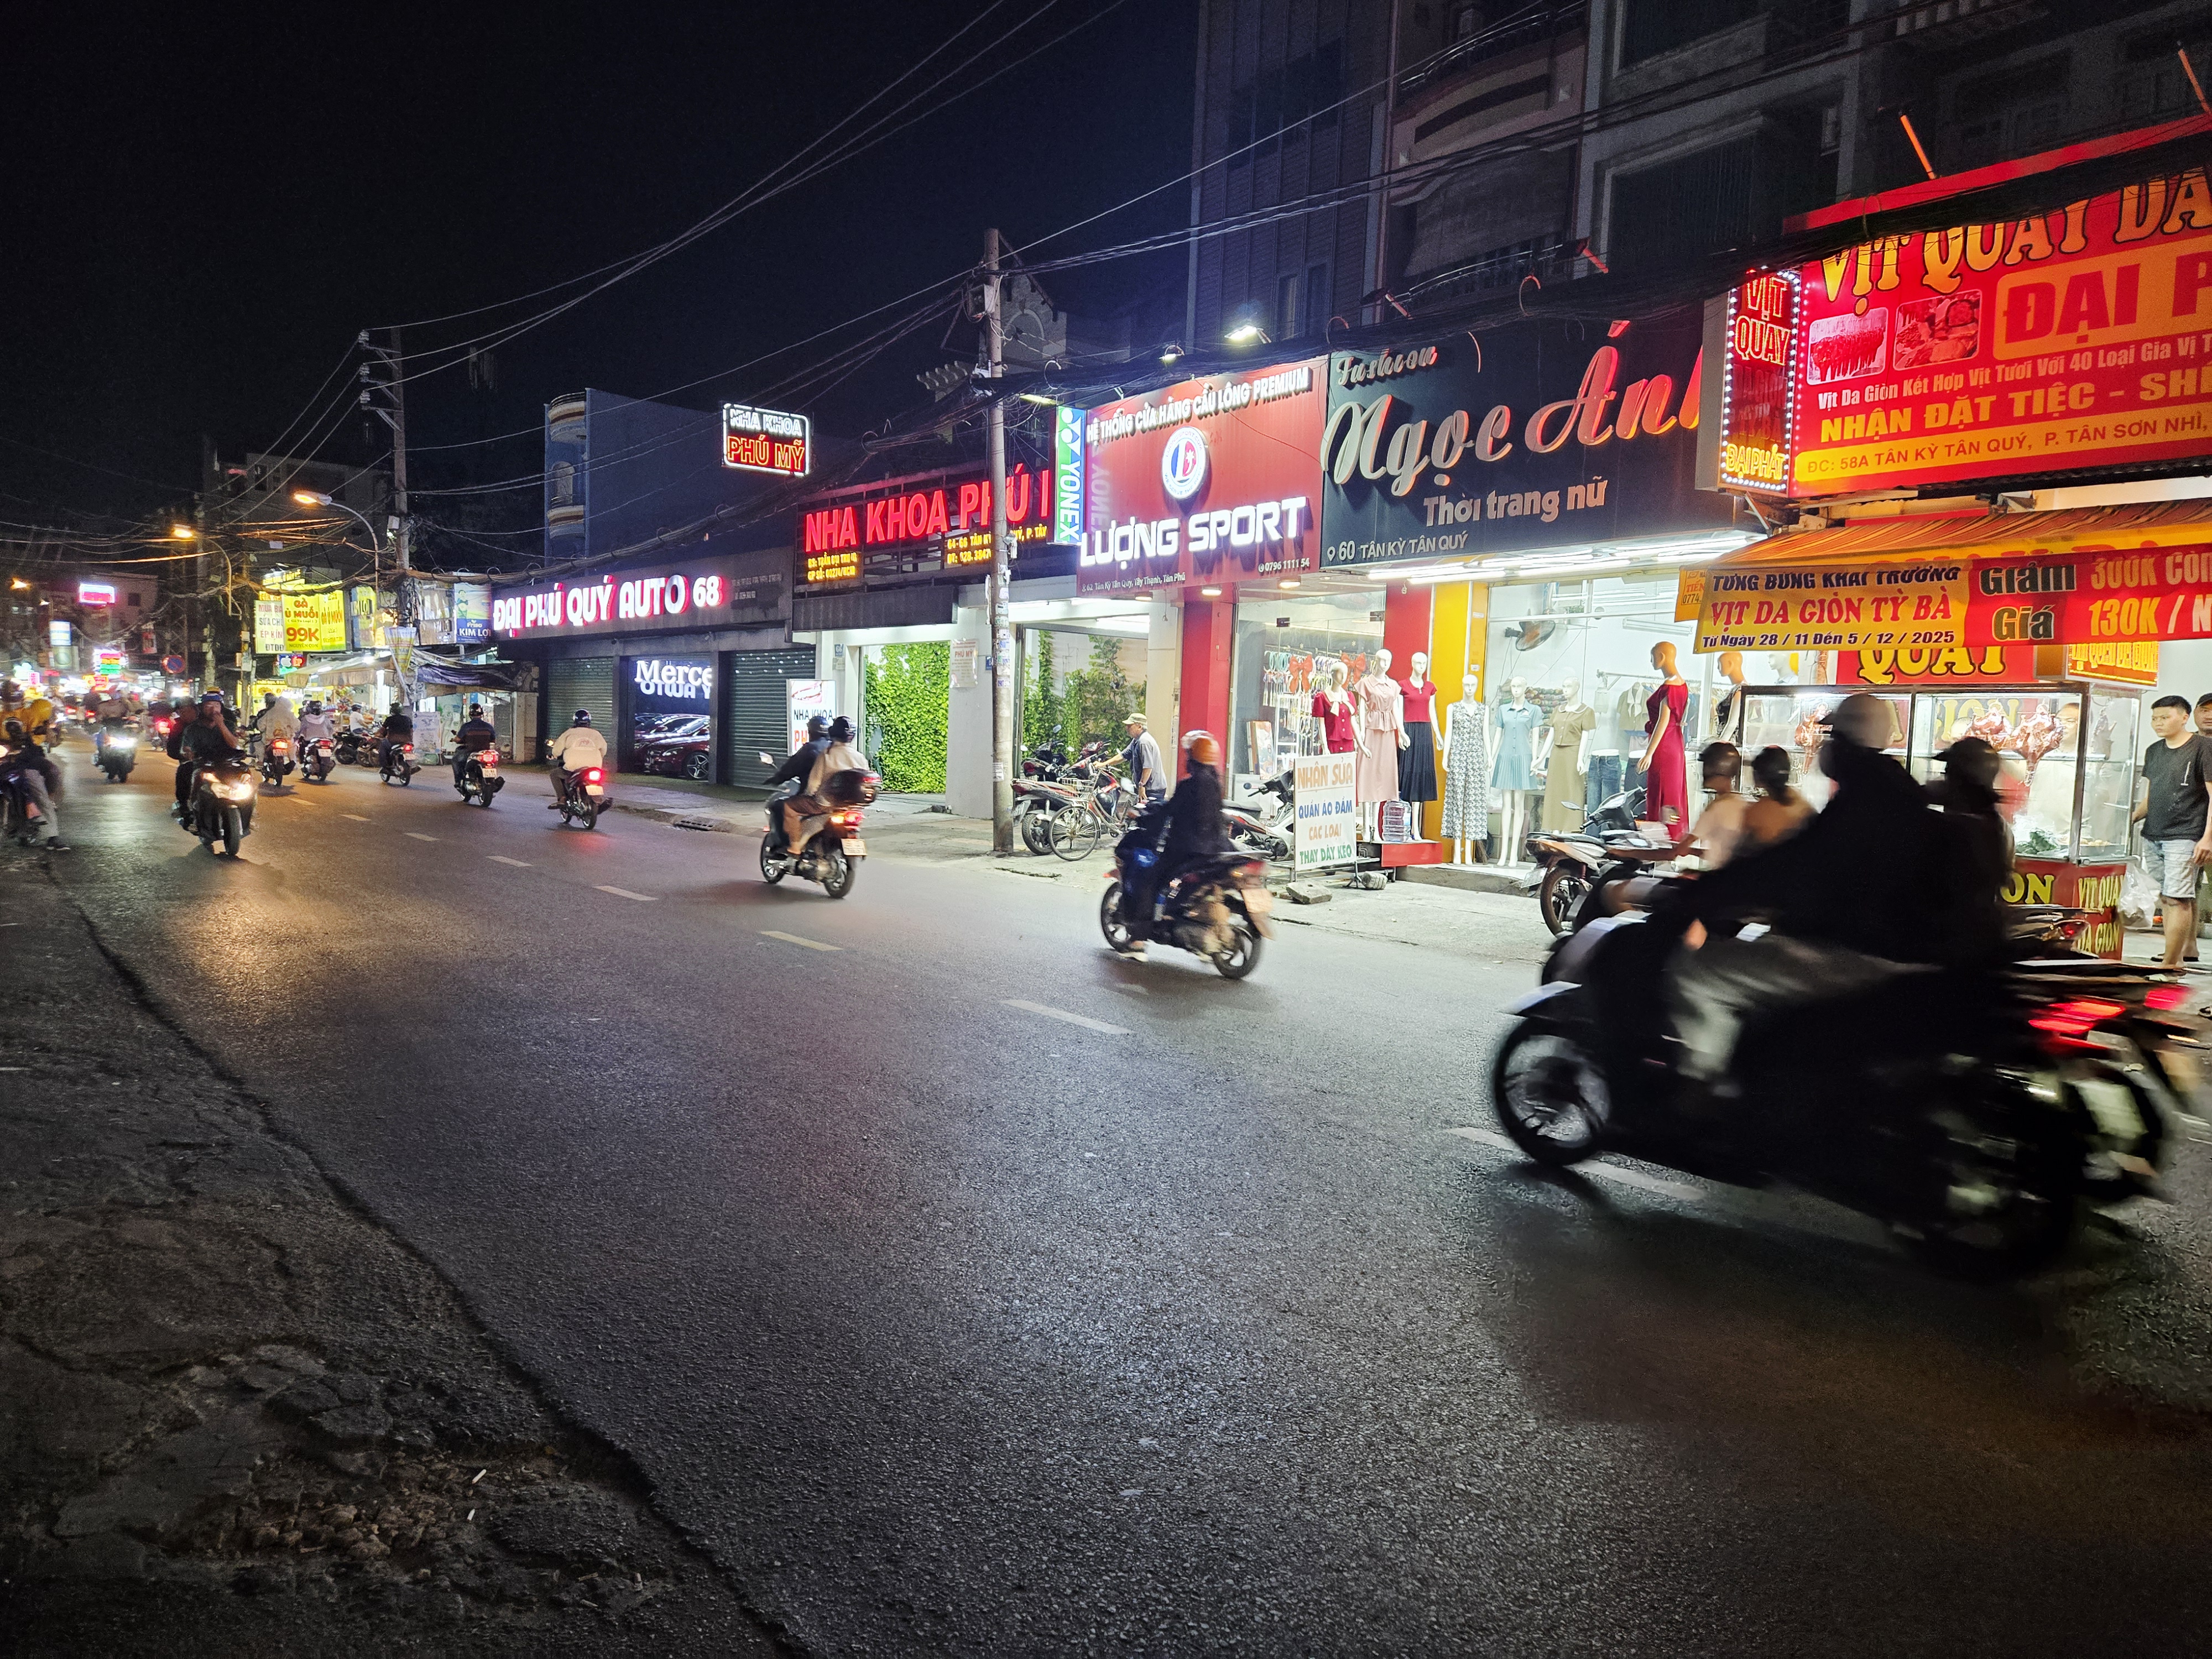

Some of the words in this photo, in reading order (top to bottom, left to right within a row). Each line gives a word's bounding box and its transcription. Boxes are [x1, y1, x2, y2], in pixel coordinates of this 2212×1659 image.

[1746, 276, 1790, 321] VỊT
[2002, 263, 2141, 344] ĐẠI
[1735, 315, 1792, 366] QUAY
[1336, 346, 1438, 386] Fashion
[1818, 390, 1838, 411] Vịt
[1841, 389, 1860, 406] Da
[1864, 383, 1898, 403] Giòn
[1902, 375, 1929, 397] Kết
[1933, 372, 1964, 395] Hợp
[1969, 367, 1990, 389] Vịt
[1995, 359, 2033, 383] Tươi
[2037, 354, 2065, 377] Với
[2069, 351, 2093, 372] 40
[2098, 345, 2135, 369] Loại
[2141, 341, 2171, 362] Gia
[2177, 335, 2197, 358] Vị
[729, 408, 762, 431] NHA
[763, 413, 802, 437] KHOA
[1086, 417, 1100, 446] HỆ
[1100, 408, 1135, 439] THỐNG
[1135, 401, 1157, 430] CỬA
[1159, 395, 1192, 424] HÀNG
[1193, 383, 1217, 415] CẦU
[1218, 381, 1252, 410] LÔNG
[1253, 366, 1311, 401] PREMIUM
[1820, 407, 1912, 443] NHẬN
[1924, 394, 1997, 429] ĐẶT
[2008, 382, 2095, 418] TIỆC
[727, 434, 769, 466] PHÚ
[775, 439, 805, 471] MỸ
[1320, 394, 1513, 497] Ngọc
[1807, 460, 1835, 473] ĐC:
[1840, 455, 1869, 470] 58A
[1875, 448, 1913, 465] TÂN
[1915, 443, 1941, 461] KỲ
[1944, 439, 1980, 457] TÂN
[1987, 431, 2032, 452] QUÝ,
[2044, 431, 2059, 446] P.
[2066, 424, 2106, 444] TÂN
[2113, 419, 2157, 439] SƠN
[2164, 411, 2208, 434] NHÌ,
[1725, 443, 1751, 479] ĐẠI
[1750, 443, 1786, 481] PHÁT
[805, 505, 857, 552] NHA
[866, 489, 949, 544] KHOA
[1059, 461, 1081, 542] YONEX
[1423, 492, 1481, 527] Thời
[1486, 489, 1561, 523] trang
[1566, 476, 1608, 511] nữ
[970, 533, 983, 546] TÂN
[1081, 516, 1180, 570] LƯỢNG
[1188, 496, 1307, 552] SPORT
[1338, 540, 1355, 561] 60
[1360, 540, 1385, 559] TÂN
[1387, 537, 1406, 556] KỲ
[1409, 534, 1436, 554] TÂN
[1438, 530, 1469, 551] QUÝ
[1095, 582, 1104, 591] Tân
[1144, 575, 1163, 587] Thạnh,
[1173, 572, 1186, 582] Phú
[1264, 561, 1282, 572] 0796
[1283, 559, 1300, 570] 1111
[1300, 557, 1310, 567] 54
[1822, 571, 1870, 588] KHAI
[1980, 561, 2077, 596] Giảm
[2090, 555, 2158, 589] 300K
[293, 598, 309, 608] GÀ
[293, 606, 319, 619] MUỐI
[493, 597, 523, 638] ĐẠI
[525, 582, 564, 628] PHÚ
[566, 575, 615, 626] QUÝ
[619, 575, 688, 619] AUTO
[692, 575, 721, 607] 68
[1711, 601, 1750, 632] VỊT
[1754, 600, 1790, 624] DA
[1799, 592, 1865, 624] GIÒN
[1871, 588, 1909, 622] TỲ
[1912, 585, 1952, 621] BÀ
[1992, 604, 2055, 641] Giá
[2089, 597, 2161, 636] 130K
[2167, 594, 2185, 634] /
[286, 627, 320, 642] 99K
[459, 628, 476, 637] KIM
[477, 628, 491, 639] LỢI
[1703, 635, 1718, 648] Từ
[1720, 634, 1755, 647] Ngày
[1760, 633, 1778, 645] 28
[1782, 633, 1791, 645] /
[1794, 633, 1808, 645] 11
[1813, 631, 1843, 644] Đến
[1848, 633, 1858, 644] 5
[1862, 633, 1872, 644] /
[1876, 633, 1894, 644] 12
[1897, 632, 1907, 644] /
[1911, 630, 1955, 643] 2025
[794, 709, 810, 721] NHA
[1297, 761, 1329, 793] NHẬN
[1332, 757, 1353, 786] SỬA
[1322, 799, 1333, 816] ÁO
[1308, 823, 1322, 841] CÁC
[1324, 823, 1342, 841] LOẠI
[1300, 848, 1318, 864] THAY
[1321, 844, 1335, 862] DÂY
[1338, 842, 1352, 859] KÉO
